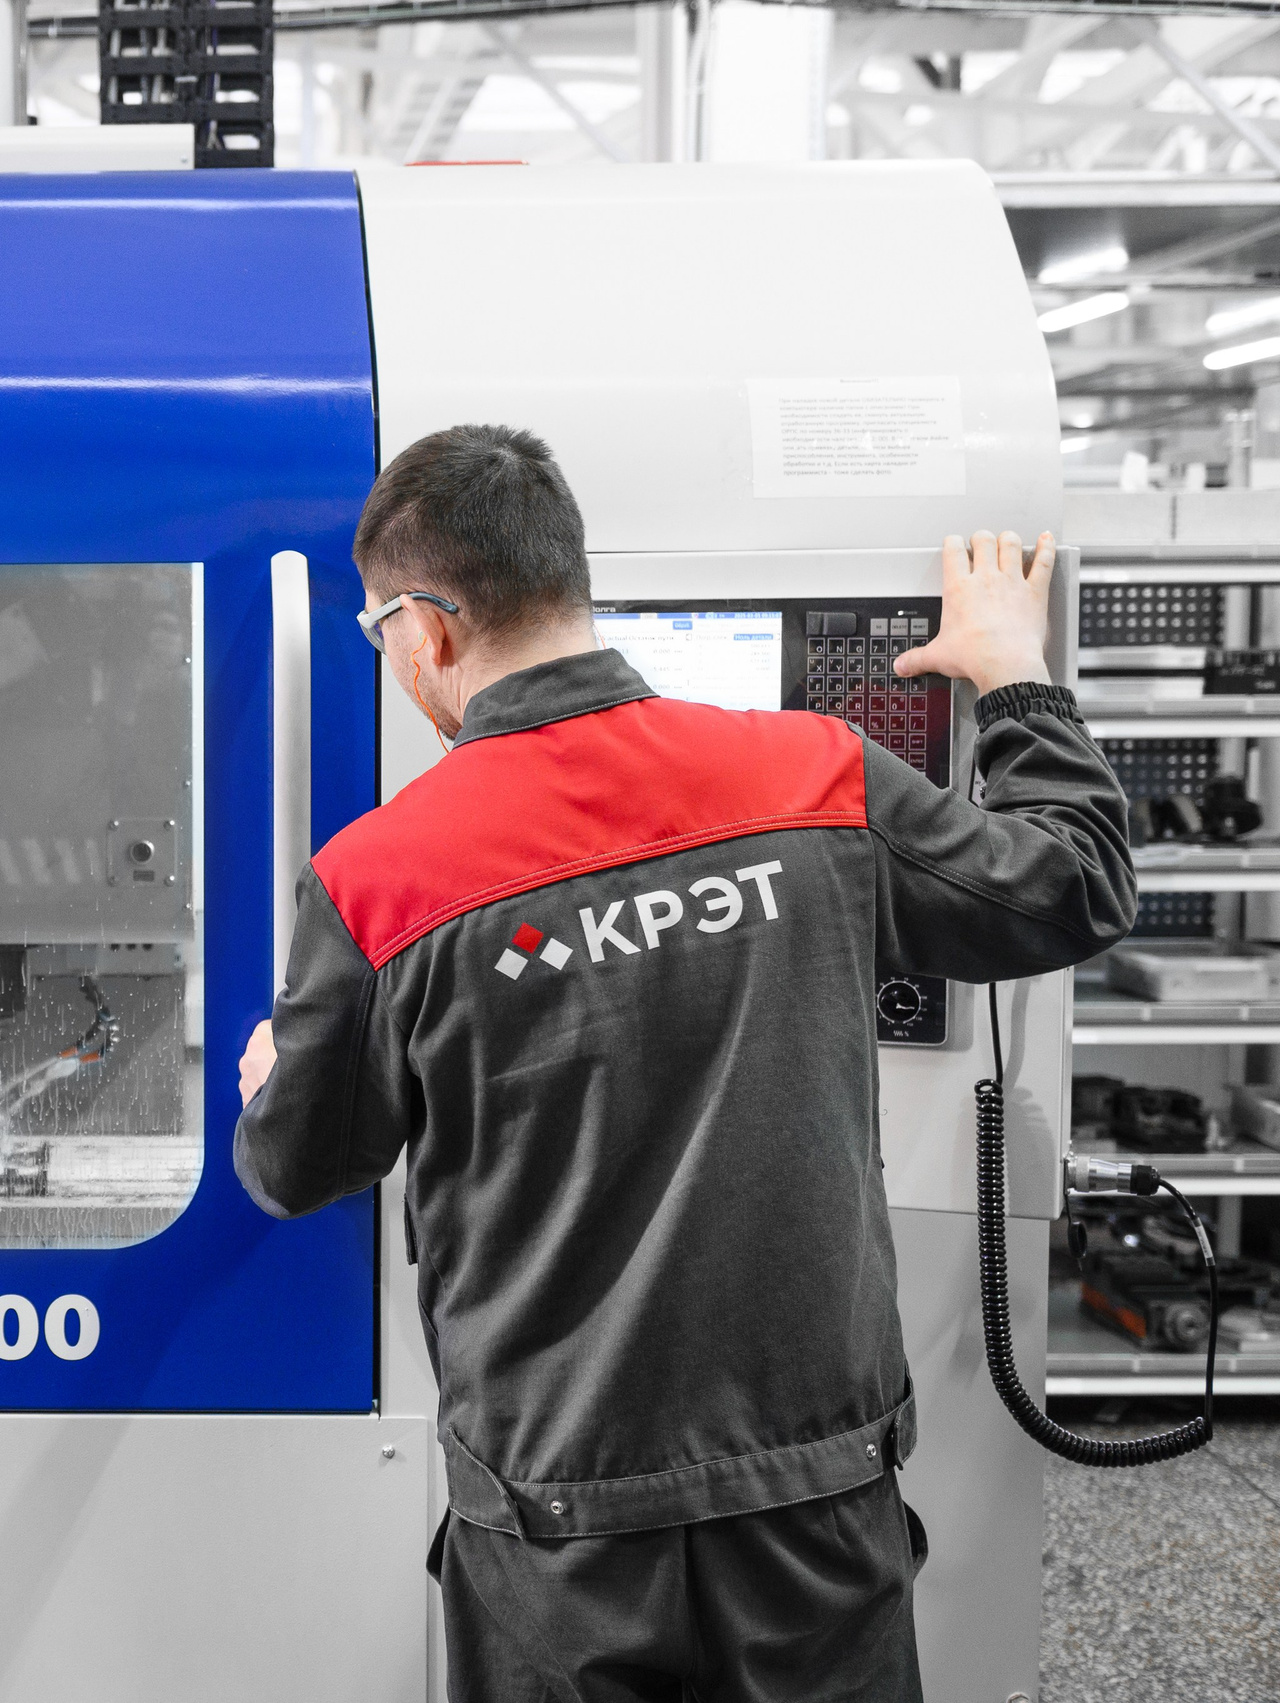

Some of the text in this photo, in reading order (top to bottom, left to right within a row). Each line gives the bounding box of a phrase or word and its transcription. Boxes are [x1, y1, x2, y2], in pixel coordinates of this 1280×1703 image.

[836, 645, 843, 653] N
[856, 645, 863, 653] G
[579, 860, 783, 963] КРЭТ
